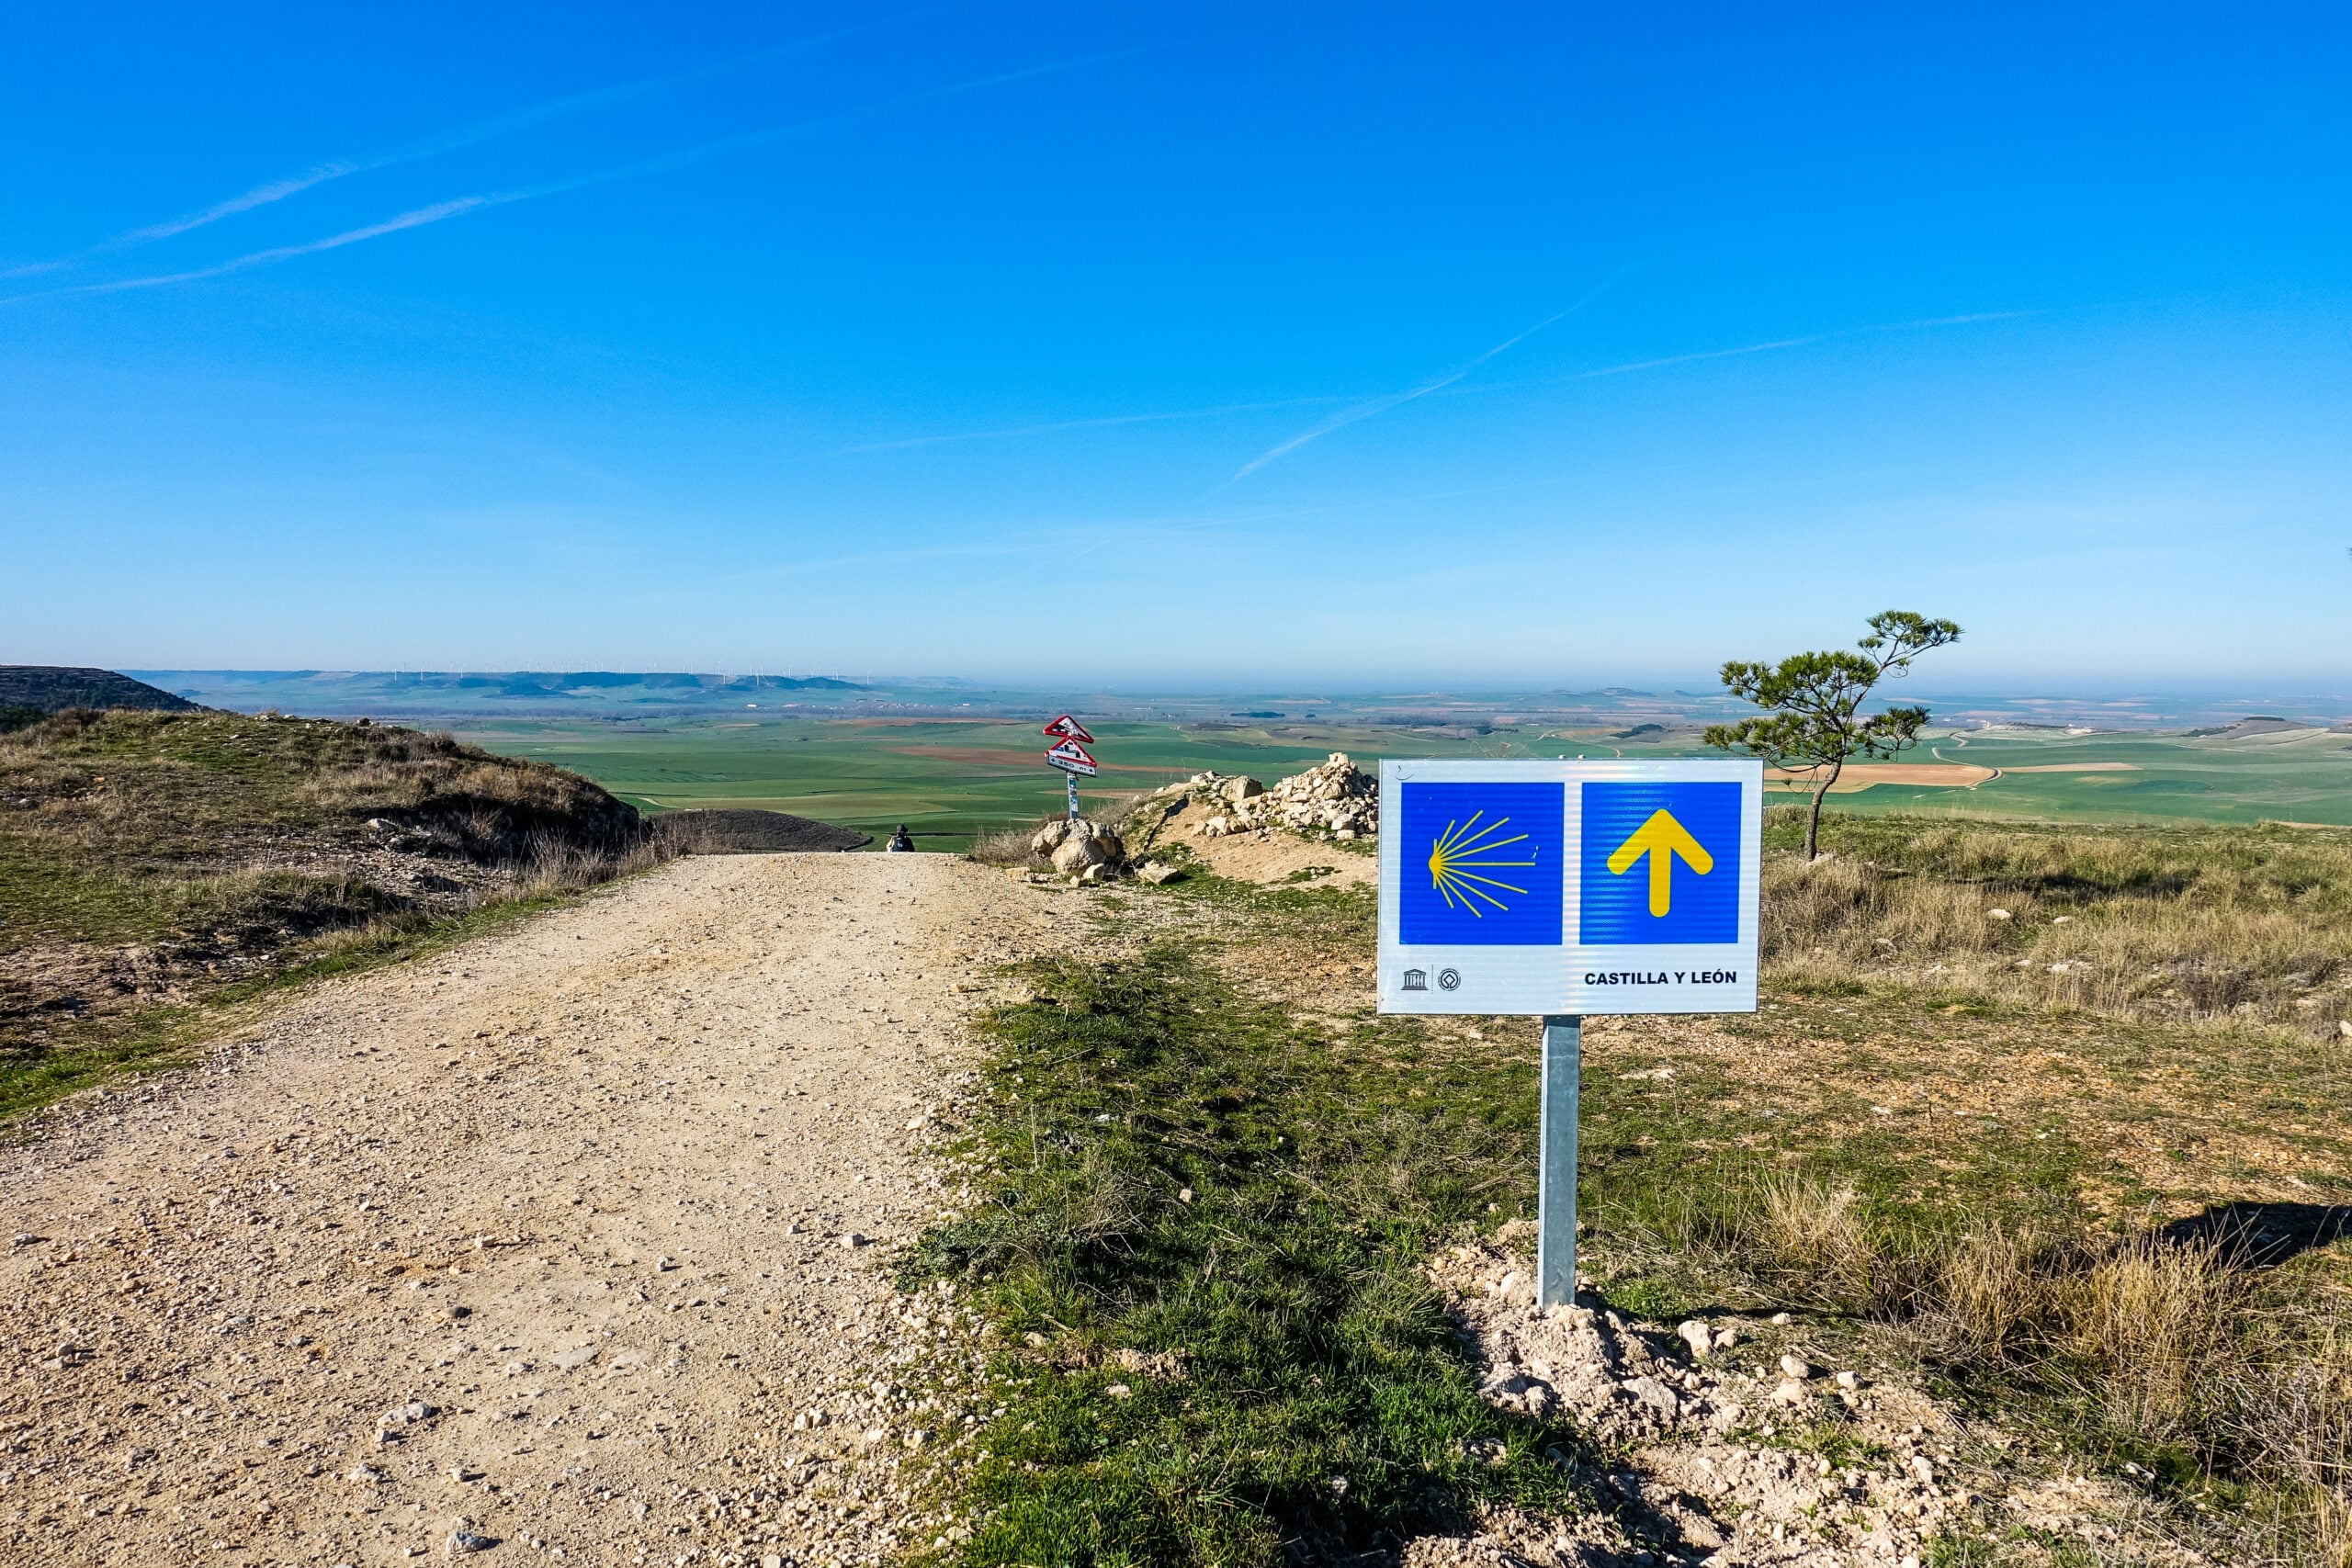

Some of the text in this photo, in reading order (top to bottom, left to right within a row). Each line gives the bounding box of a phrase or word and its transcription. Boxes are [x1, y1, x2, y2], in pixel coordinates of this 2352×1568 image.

[1057, 760, 1074, 768] 350
[1584, 969, 1737, 985] CASTILLA Y LEÓN
